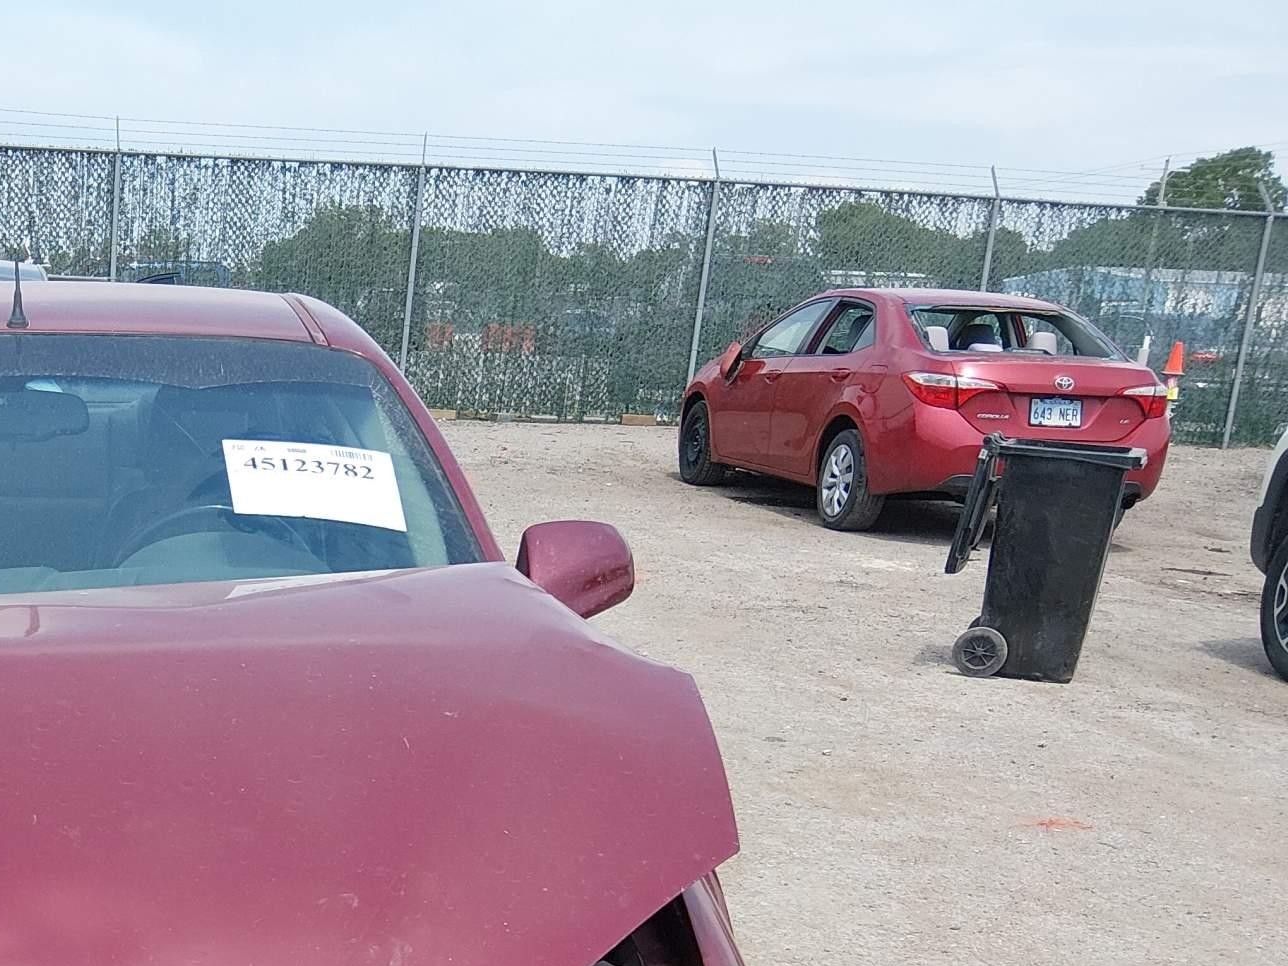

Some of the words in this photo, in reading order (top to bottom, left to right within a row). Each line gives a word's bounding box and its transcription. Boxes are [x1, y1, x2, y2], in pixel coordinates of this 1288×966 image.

[1032, 408, 1052, 421] 643
[1058, 408, 1078, 422] NER
[243, 456, 375, 480] 45123782
